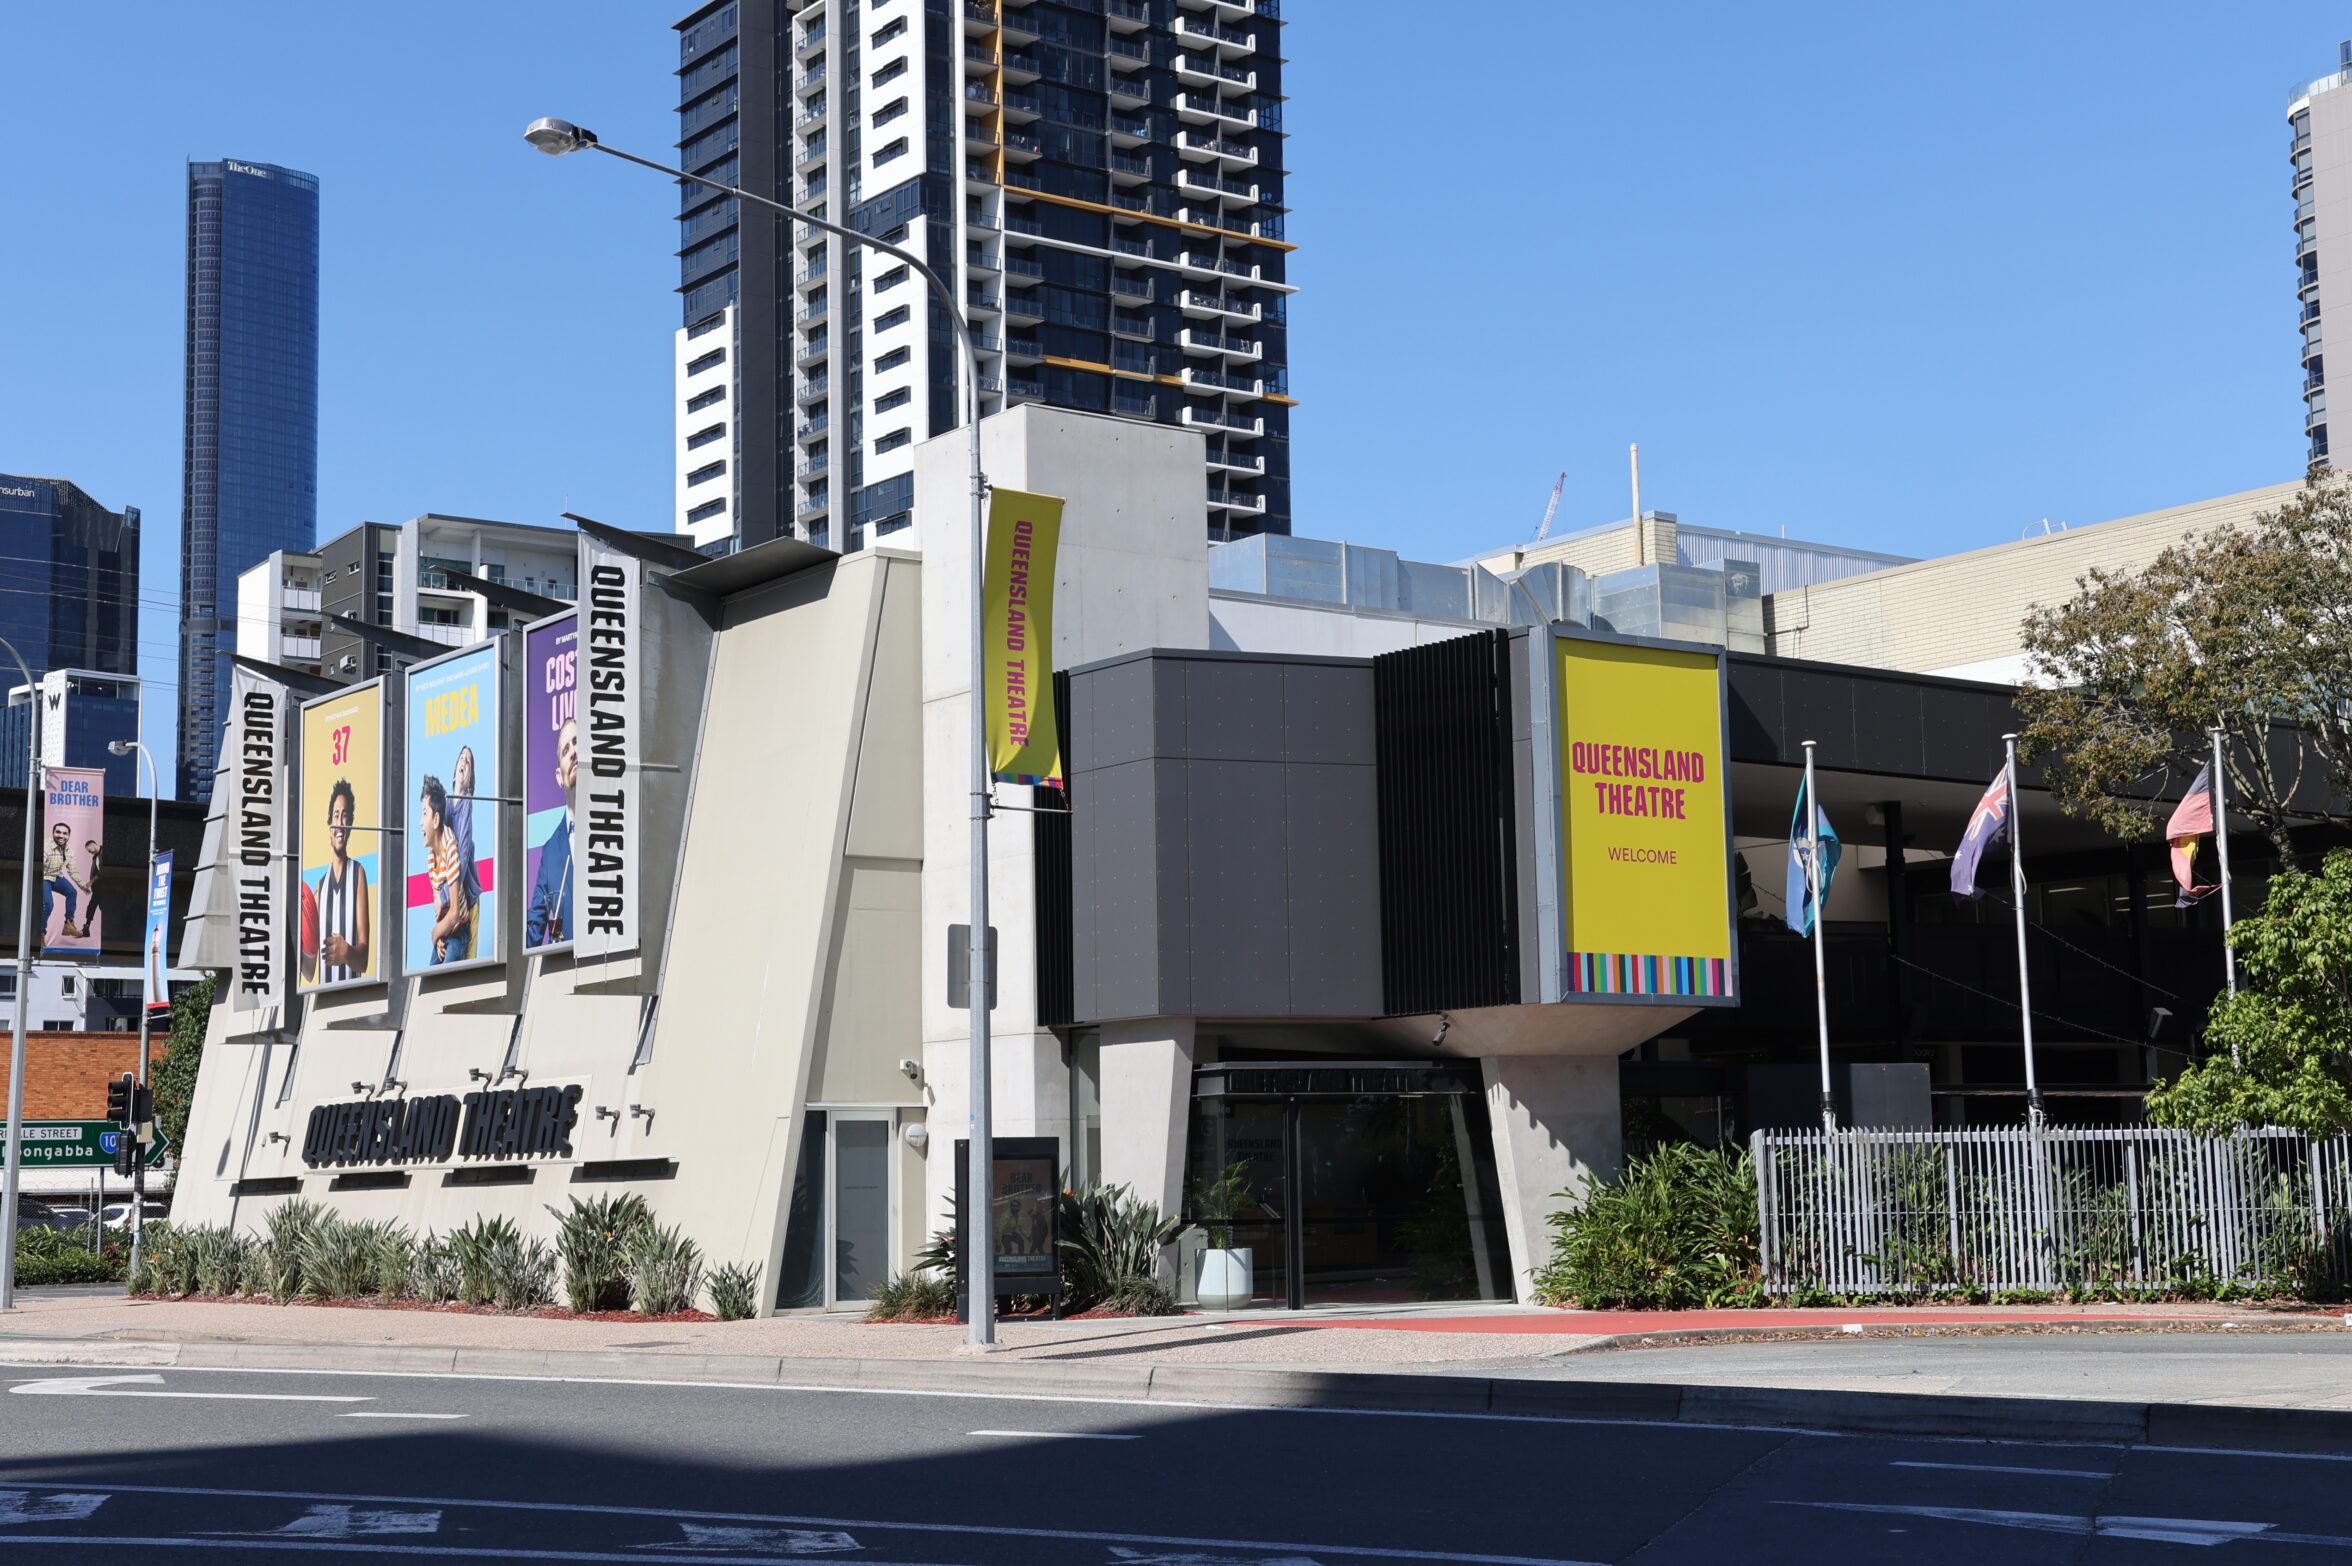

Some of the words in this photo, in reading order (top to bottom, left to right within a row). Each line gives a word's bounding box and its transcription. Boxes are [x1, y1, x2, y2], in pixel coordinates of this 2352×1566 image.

[1007, 520, 1033, 651] QUEENSLAND
[546, 649, 577, 693] COS
[589, 564, 626, 778] QUEENSLAND
[49, 693, 61, 711] W
[425, 683, 479, 739] MEDEA
[1007, 659, 1029, 747] THEATRE
[332, 725, 350, 766] 37
[1572, 741, 1705, 783] QUEENSLAND
[49, 792, 99, 807] BROTHER
[60, 780, 89, 793] DEAR
[241, 691, 274, 867] QUEENSLAND
[1594, 782, 1686, 819] THEATRE
[587, 789, 625, 935] THEATRE
[1608, 846, 1677, 865] WELCOME
[239, 876, 271, 995] THEATRE
[40, 1128, 78, 1139] STREET
[105, 1135, 117, 1147] 10
[302, 1094, 461, 1166] QUEENSLAND
[458, 1085, 583, 1158] THEATRE
